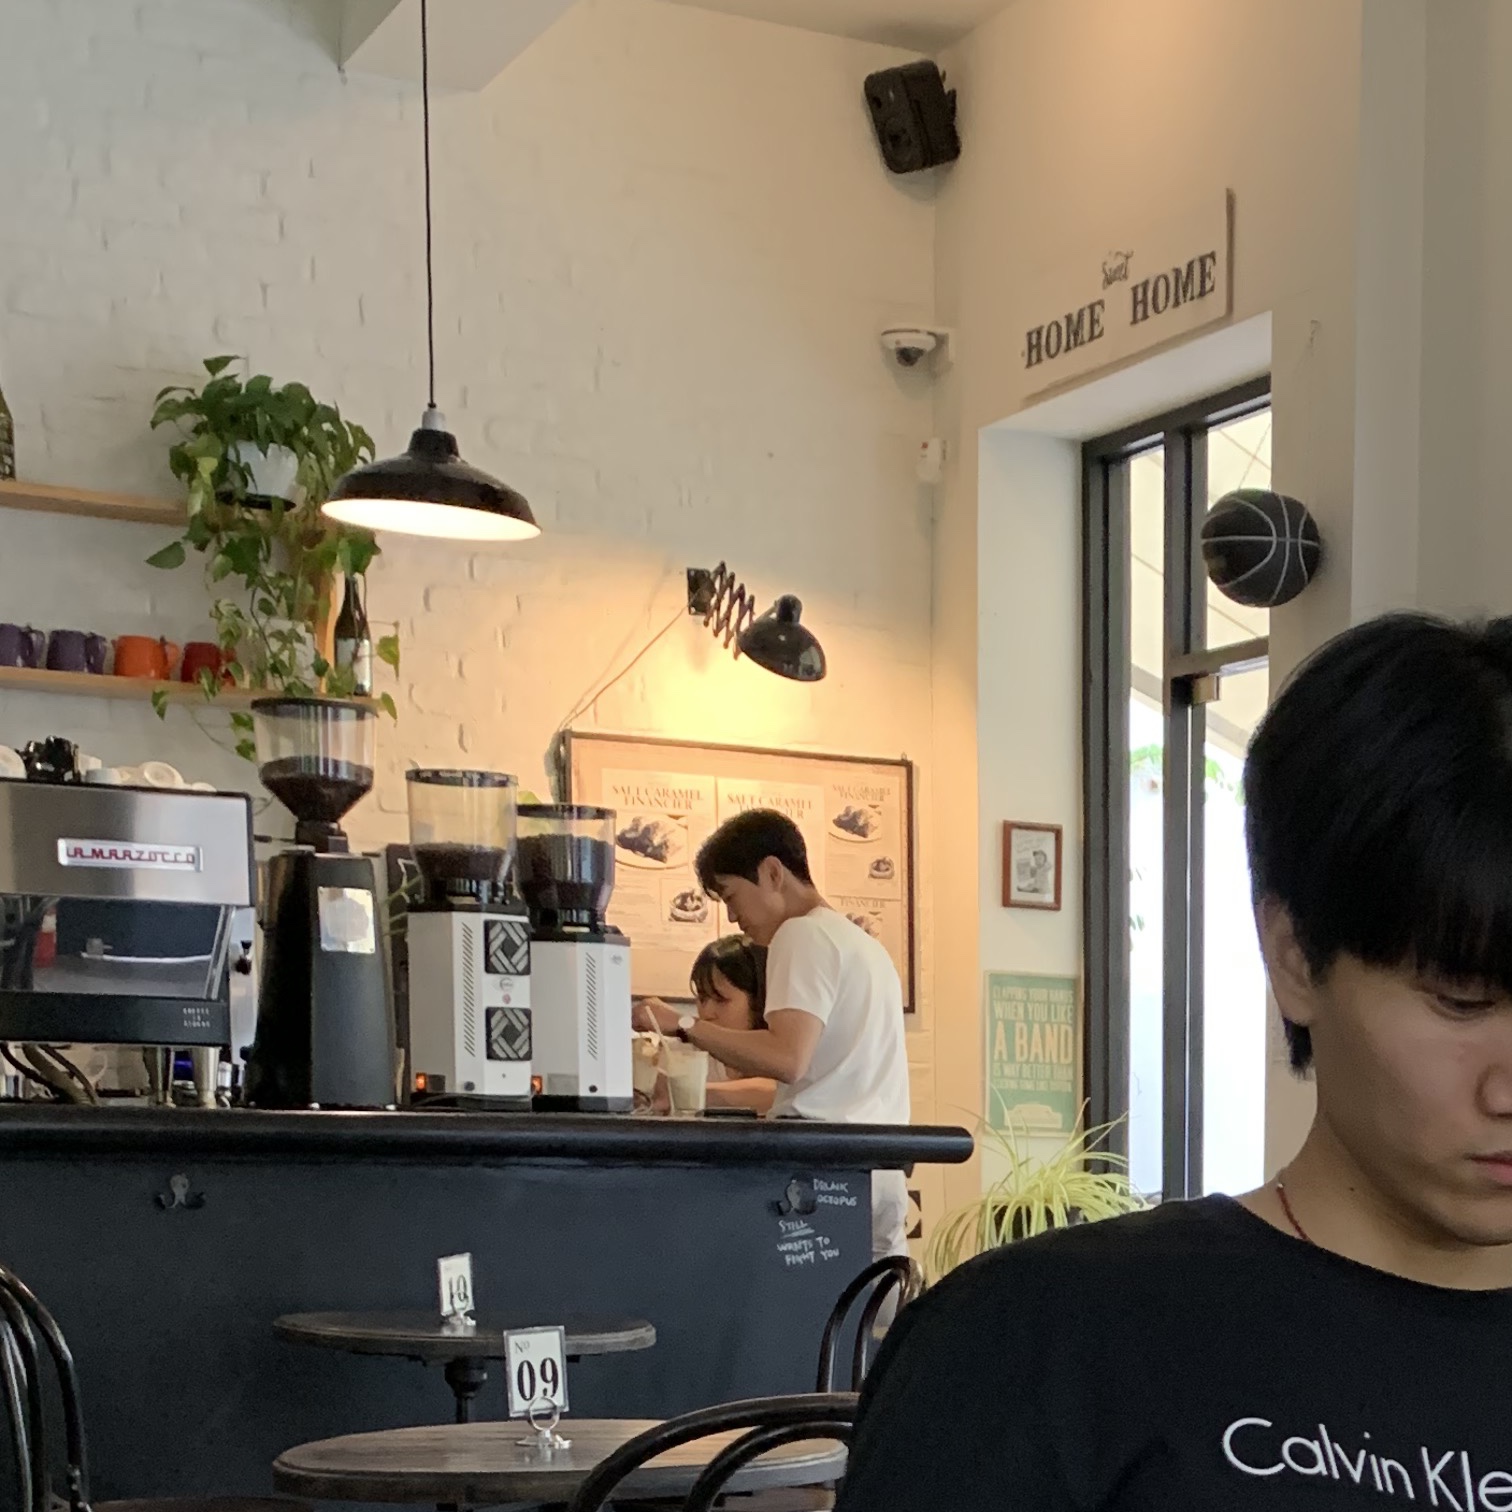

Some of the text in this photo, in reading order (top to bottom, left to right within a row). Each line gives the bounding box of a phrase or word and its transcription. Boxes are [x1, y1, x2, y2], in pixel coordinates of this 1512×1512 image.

[1024, 299, 1105, 369] HOME
[1130, 250, 1217, 327] HOME
[993, 1000, 1073, 1024] WHEN YOU LIKE
[994, 1020, 1073, 1064] A BAND
[817, 1194, 858, 1207] OCTOPUS
[778, 1219, 808, 1233] STILL
[776, 1236, 830, 1252] WANTS TO
[820, 1248, 840, 1260] YOU
[448, 1274, 469, 1302] 10
[517, 1357, 559, 1401] 09
[1222, 1417, 1415, 1500] Calvin
